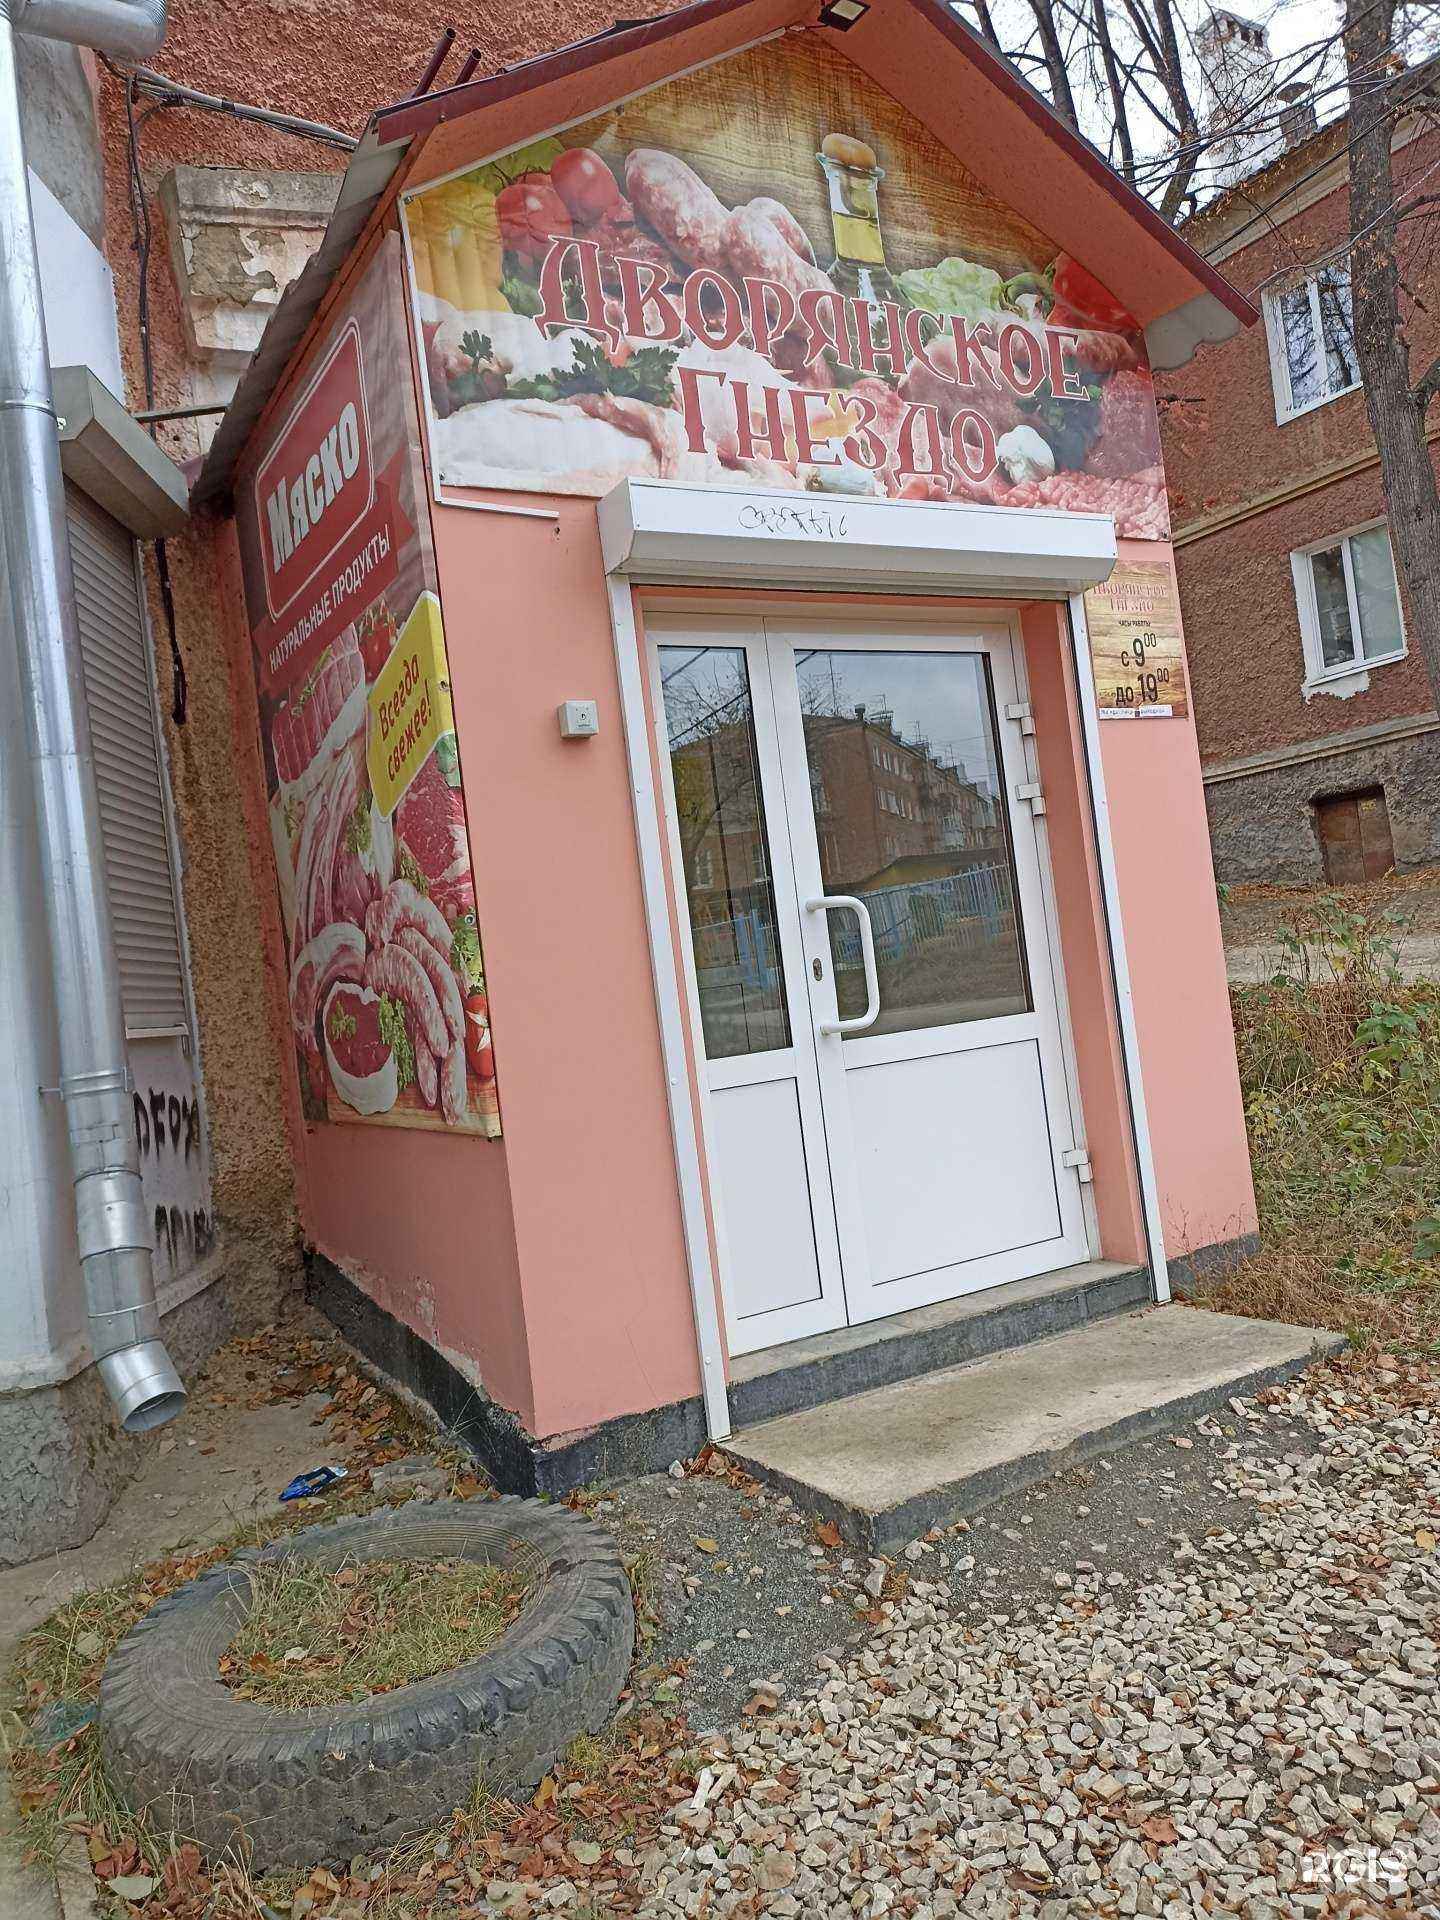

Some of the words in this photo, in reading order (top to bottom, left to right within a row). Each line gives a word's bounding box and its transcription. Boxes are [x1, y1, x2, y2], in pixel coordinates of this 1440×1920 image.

[533, 235, 1091, 401] ДВОРЯНСКОЕ
[677, 365, 999, 495] ГНЕЗДО
[269, 590, 332, 674] НАТУРАЛЬНЫЕ
[331, 523, 391, 608] ПРОДУКТЫ
[379, 654, 420, 741] Всегда
[388, 678, 432, 782] свежее!
